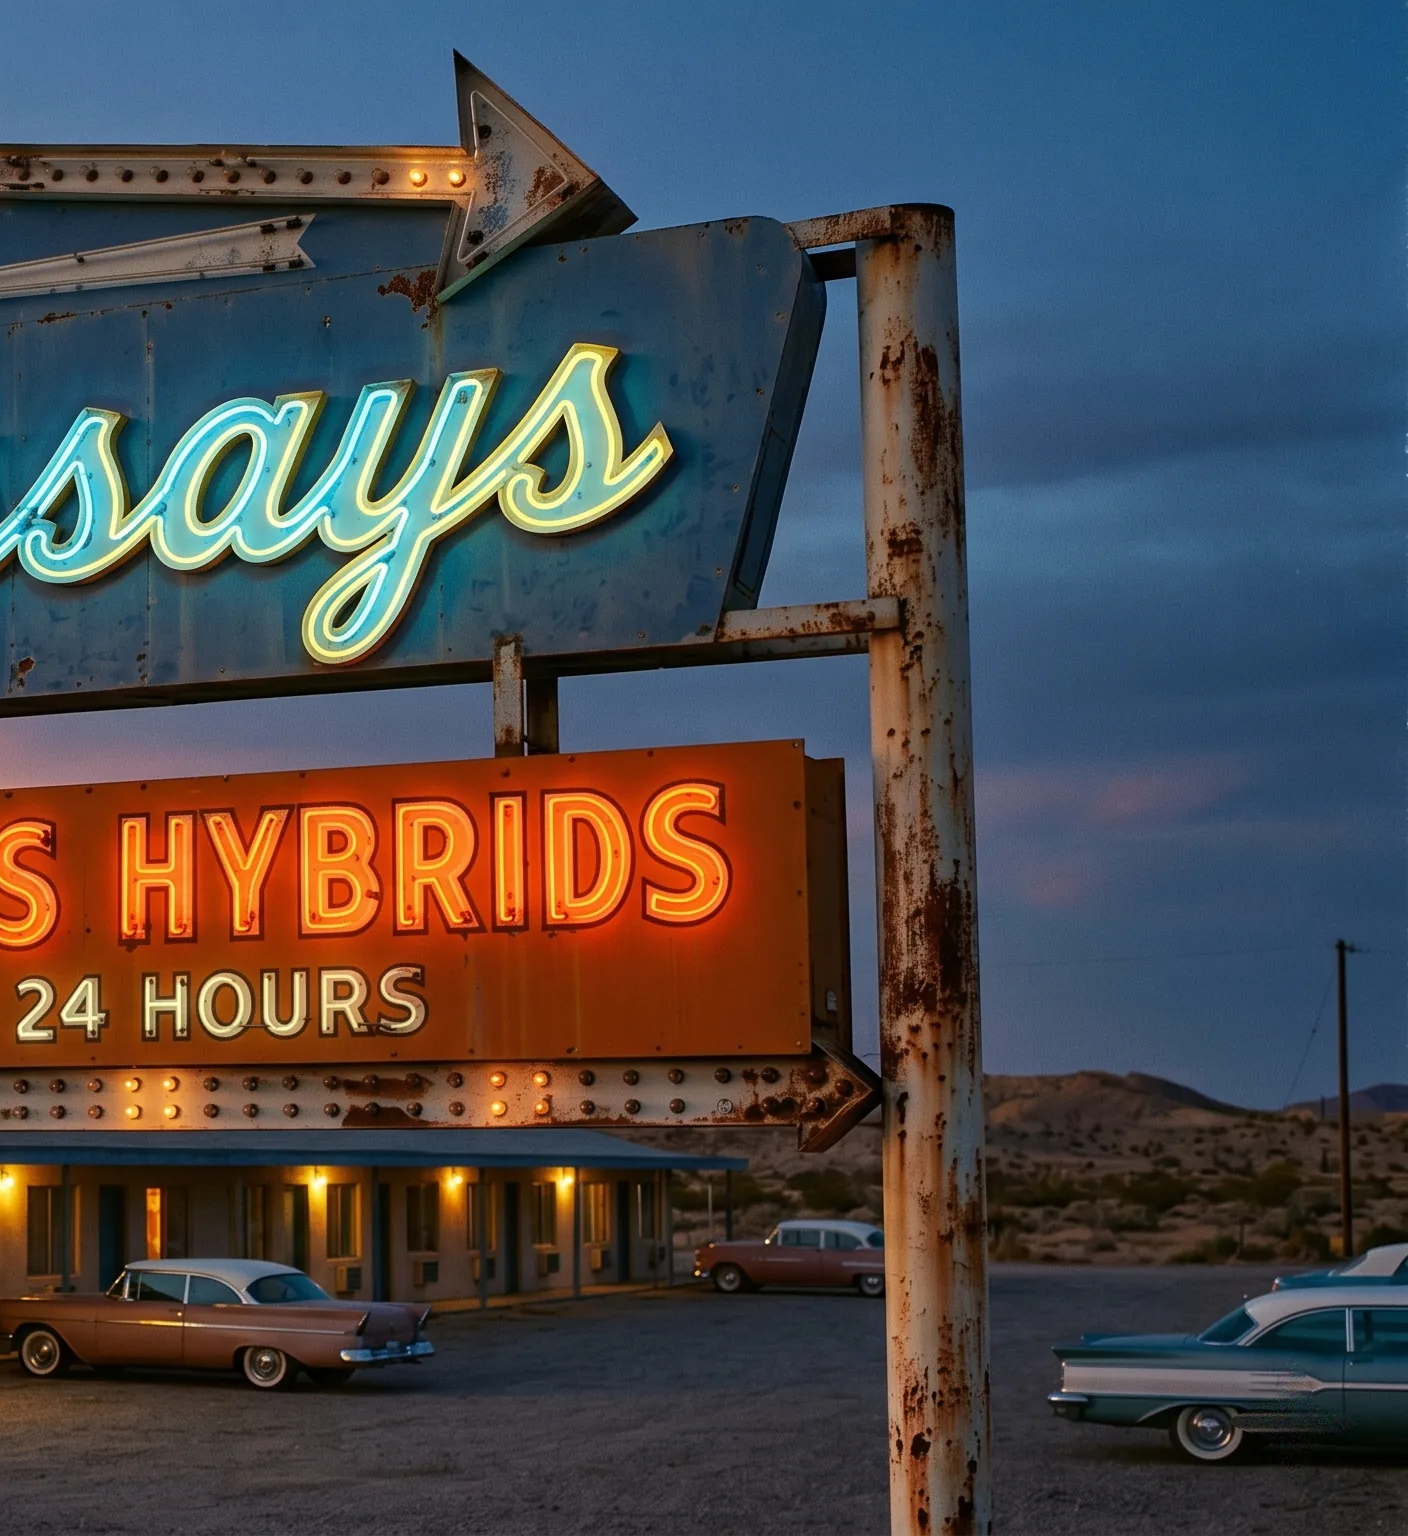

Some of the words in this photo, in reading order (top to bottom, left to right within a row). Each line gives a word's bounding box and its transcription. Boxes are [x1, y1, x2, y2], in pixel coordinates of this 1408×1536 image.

[118, 781, 734, 944] HYBRIDS
[15, 974, 109, 1043] 24
[141, 963, 429, 1041] HOURS
